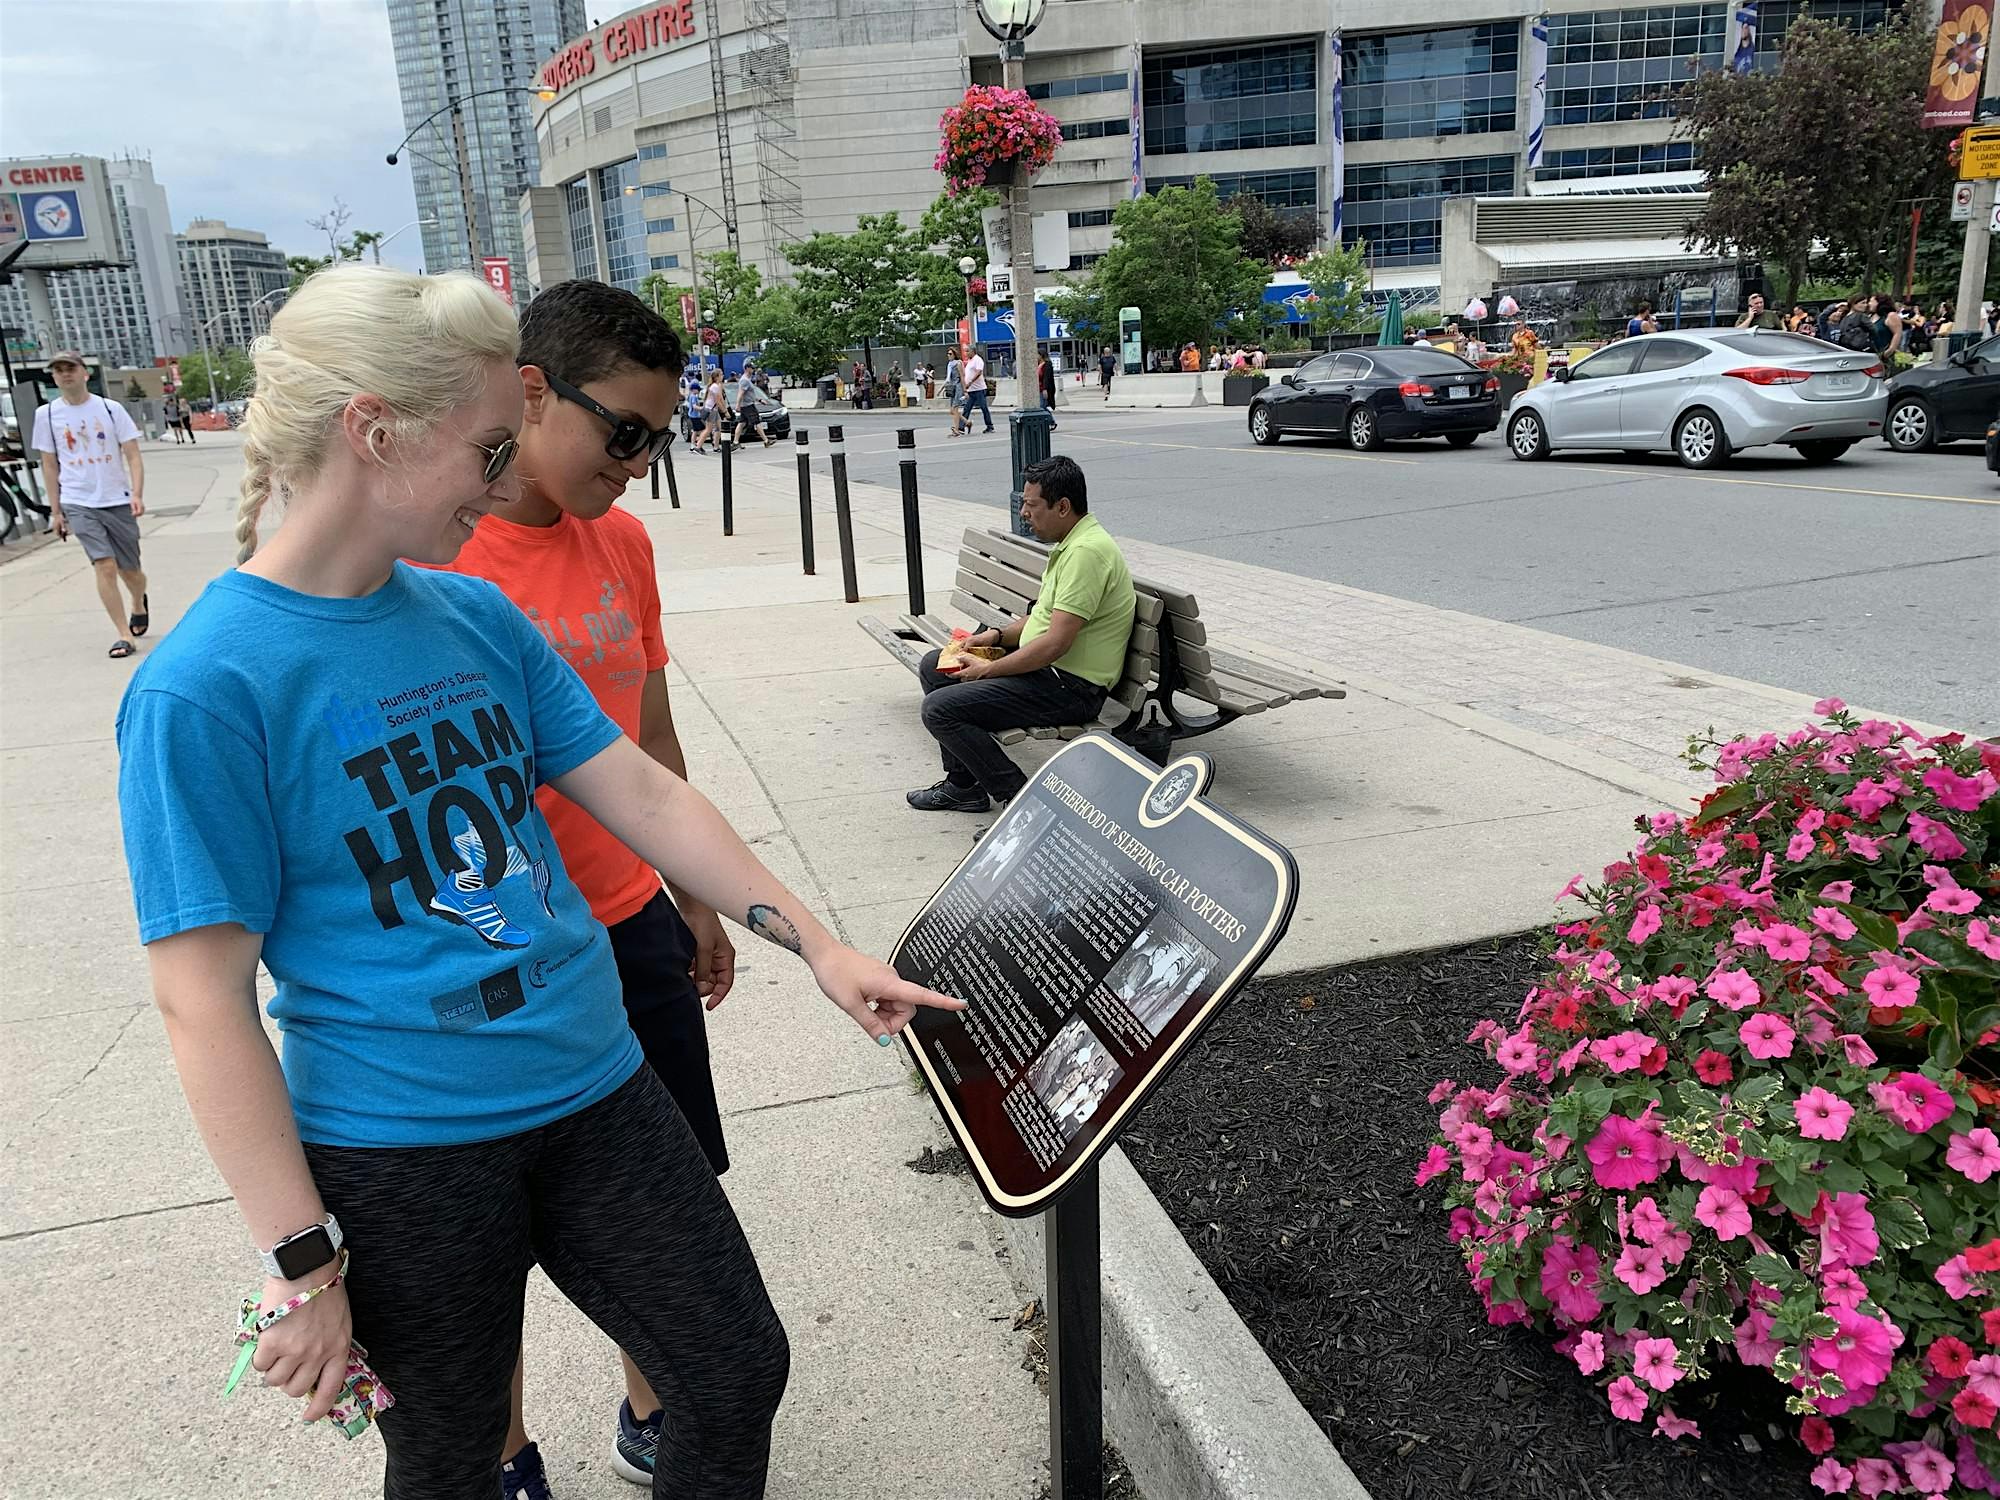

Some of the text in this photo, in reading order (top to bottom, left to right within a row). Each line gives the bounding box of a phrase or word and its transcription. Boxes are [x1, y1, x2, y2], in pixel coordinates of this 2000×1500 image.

[603, 0, 695, 63] CENTRE
[8, 165, 85, 186] CENTRE
[1980, 162, 1998, 170] ZONE
[490, 266, 504, 287] 9
[1055, 325, 1062, 336] 6
[376, 676, 455, 711] Huntington's
[386, 687, 489, 728] Society of America
[342, 703, 526, 812] TEAM
[1041, 771, 1108, 830] BROTHERHOOD
[1099, 819, 1121, 841] OF
[1112, 829, 1166, 878] SLEEPING
[1157, 866, 1190, 898] CAR
[1181, 885, 1247, 944] PORTERS
[441, 986, 509, 1020] TEVA CNS
